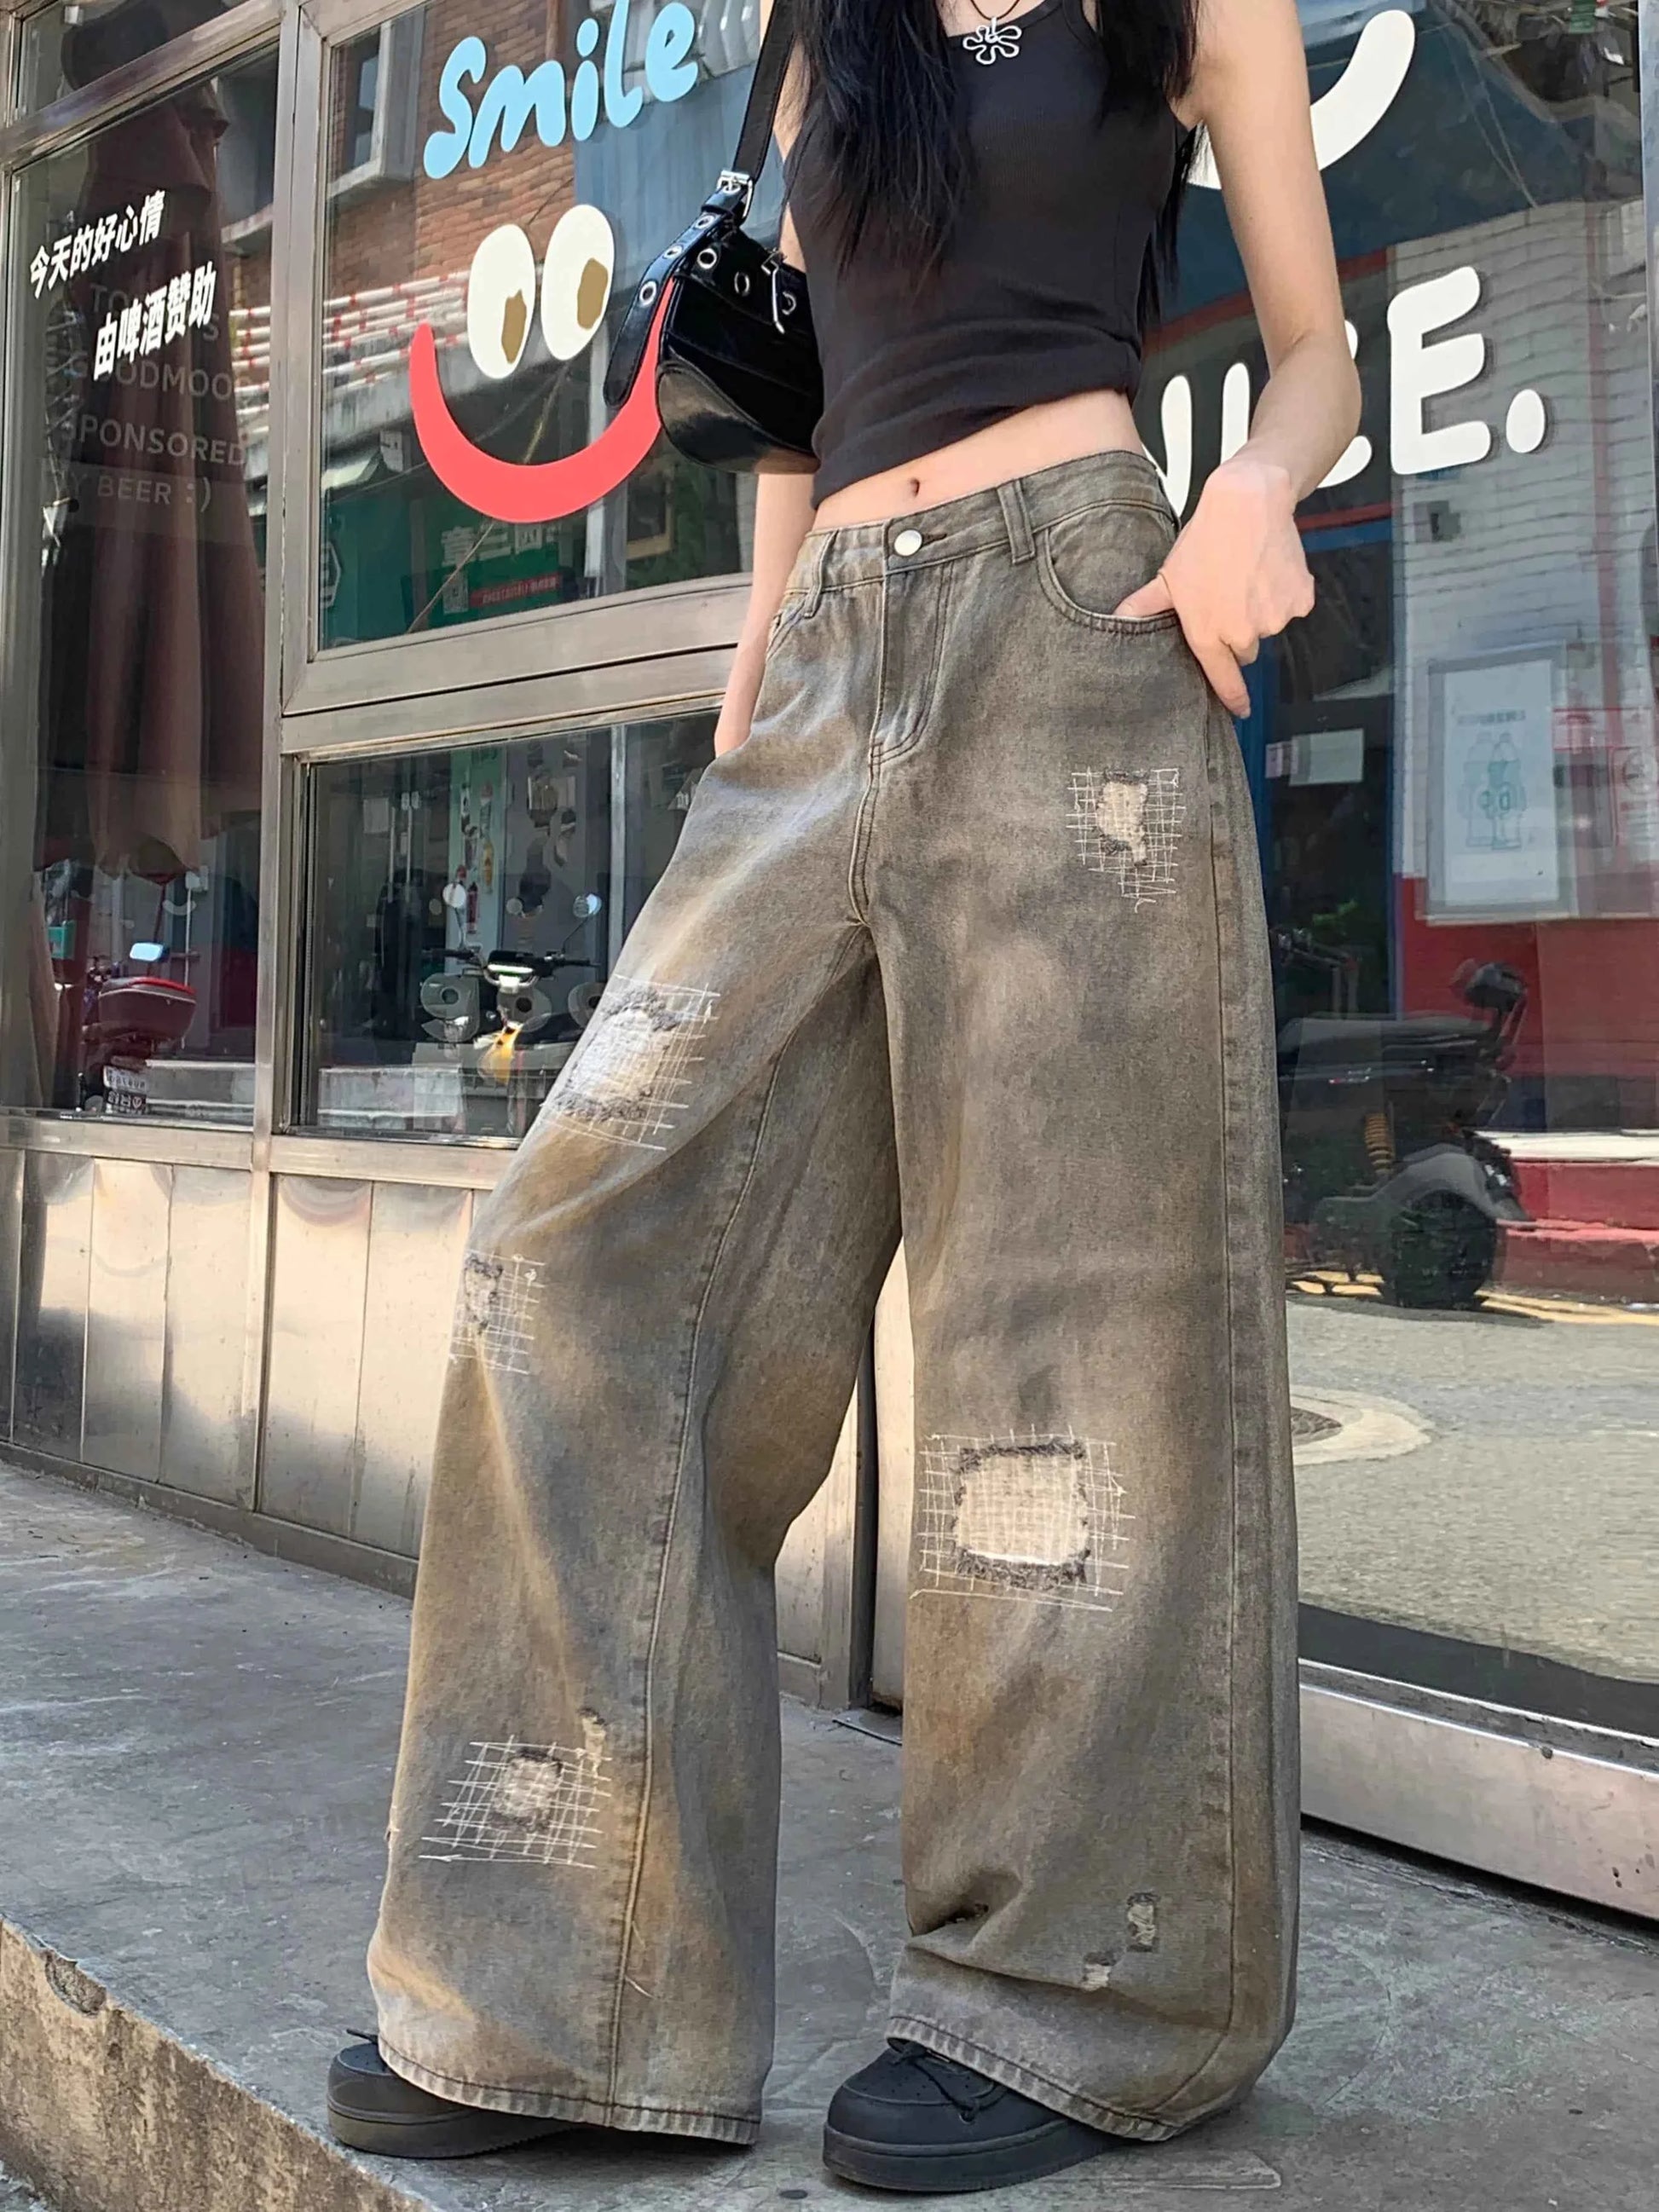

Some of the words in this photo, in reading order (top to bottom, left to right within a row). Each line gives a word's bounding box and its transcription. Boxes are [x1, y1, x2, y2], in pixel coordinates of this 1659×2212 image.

[423, 0, 698, 179] Smile
[30, 189, 165, 299] 今天的好心情
[93, 260, 217, 381] 由啤酒赞助
[97, 475, 171, 505] BEER
